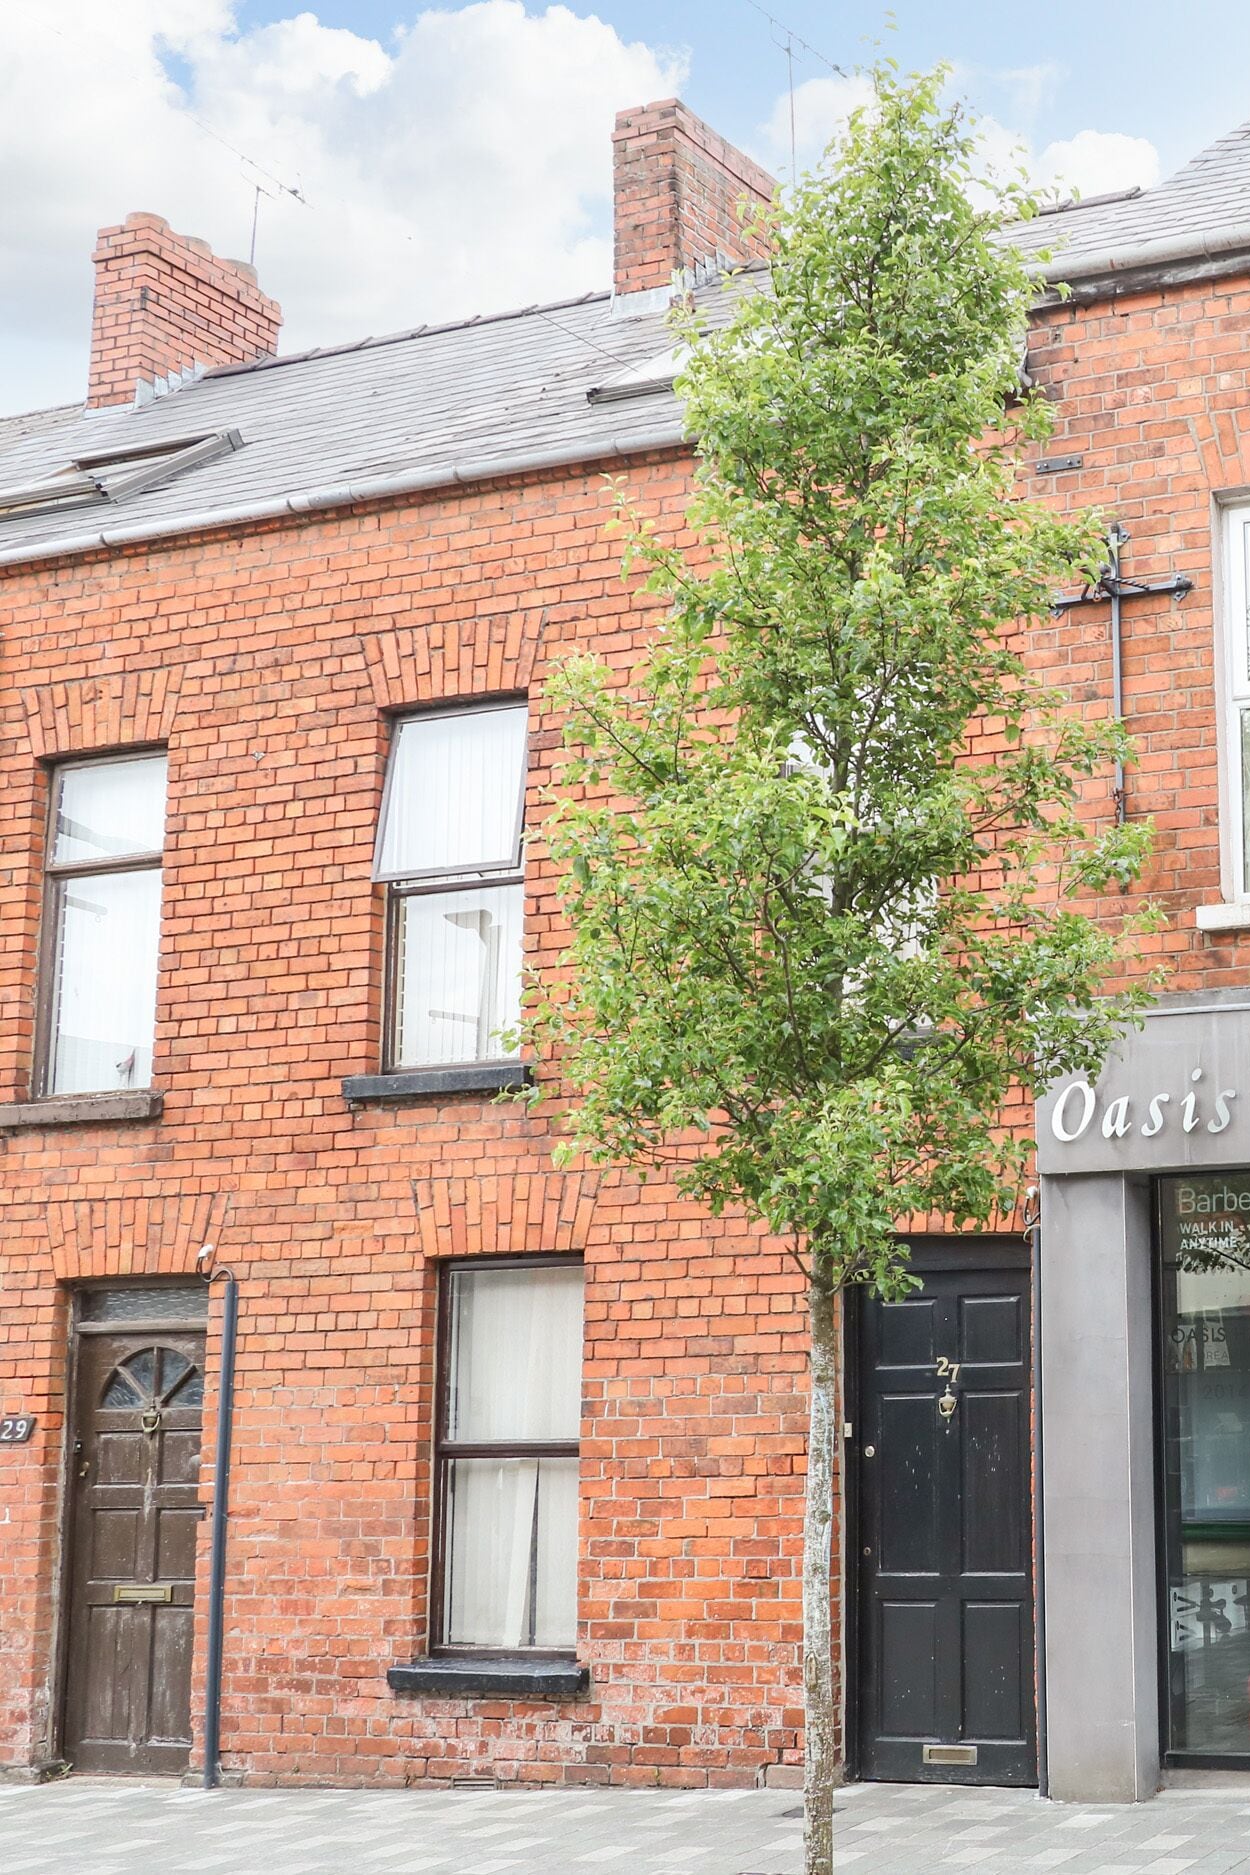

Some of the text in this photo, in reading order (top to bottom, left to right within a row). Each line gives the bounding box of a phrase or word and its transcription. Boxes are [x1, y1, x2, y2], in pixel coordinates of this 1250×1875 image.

[1050, 1067, 1238, 1142] Oasis
[1179, 1220, 1234, 1234] WALK IN
[1180, 1236, 1238, 1250] ANYTIME
[936, 1356, 960, 1383] 27
[0, 1420, 28, 1439] 29
